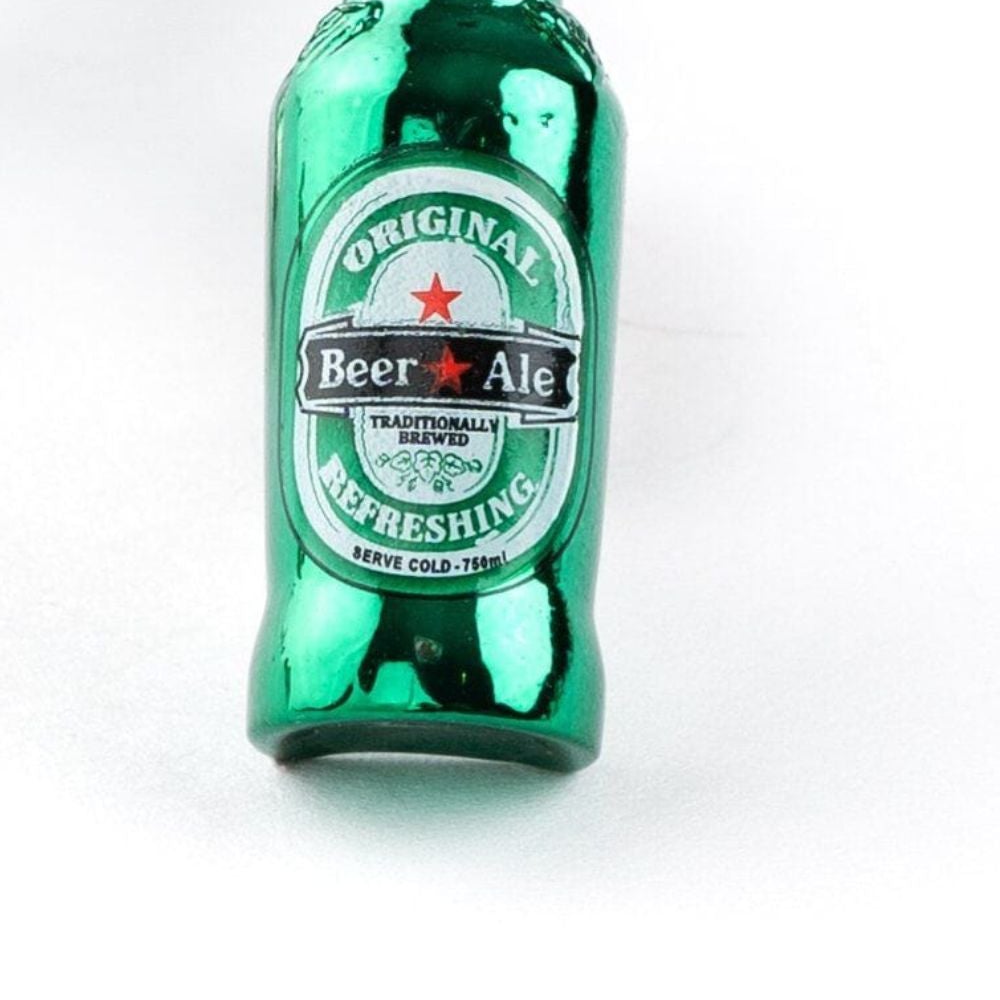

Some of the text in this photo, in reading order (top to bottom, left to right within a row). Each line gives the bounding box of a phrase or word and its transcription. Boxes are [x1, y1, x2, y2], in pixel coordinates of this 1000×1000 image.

[343, 205, 541, 287] ORIGINAL
[318, 349, 555, 395] Beer Ale
[370, 414, 499, 434] TRADITIONALLY
[398, 432, 470, 447] BREWED
[318, 453, 535, 543] REFRESHING
[352, 545, 403, 570] SERVE
